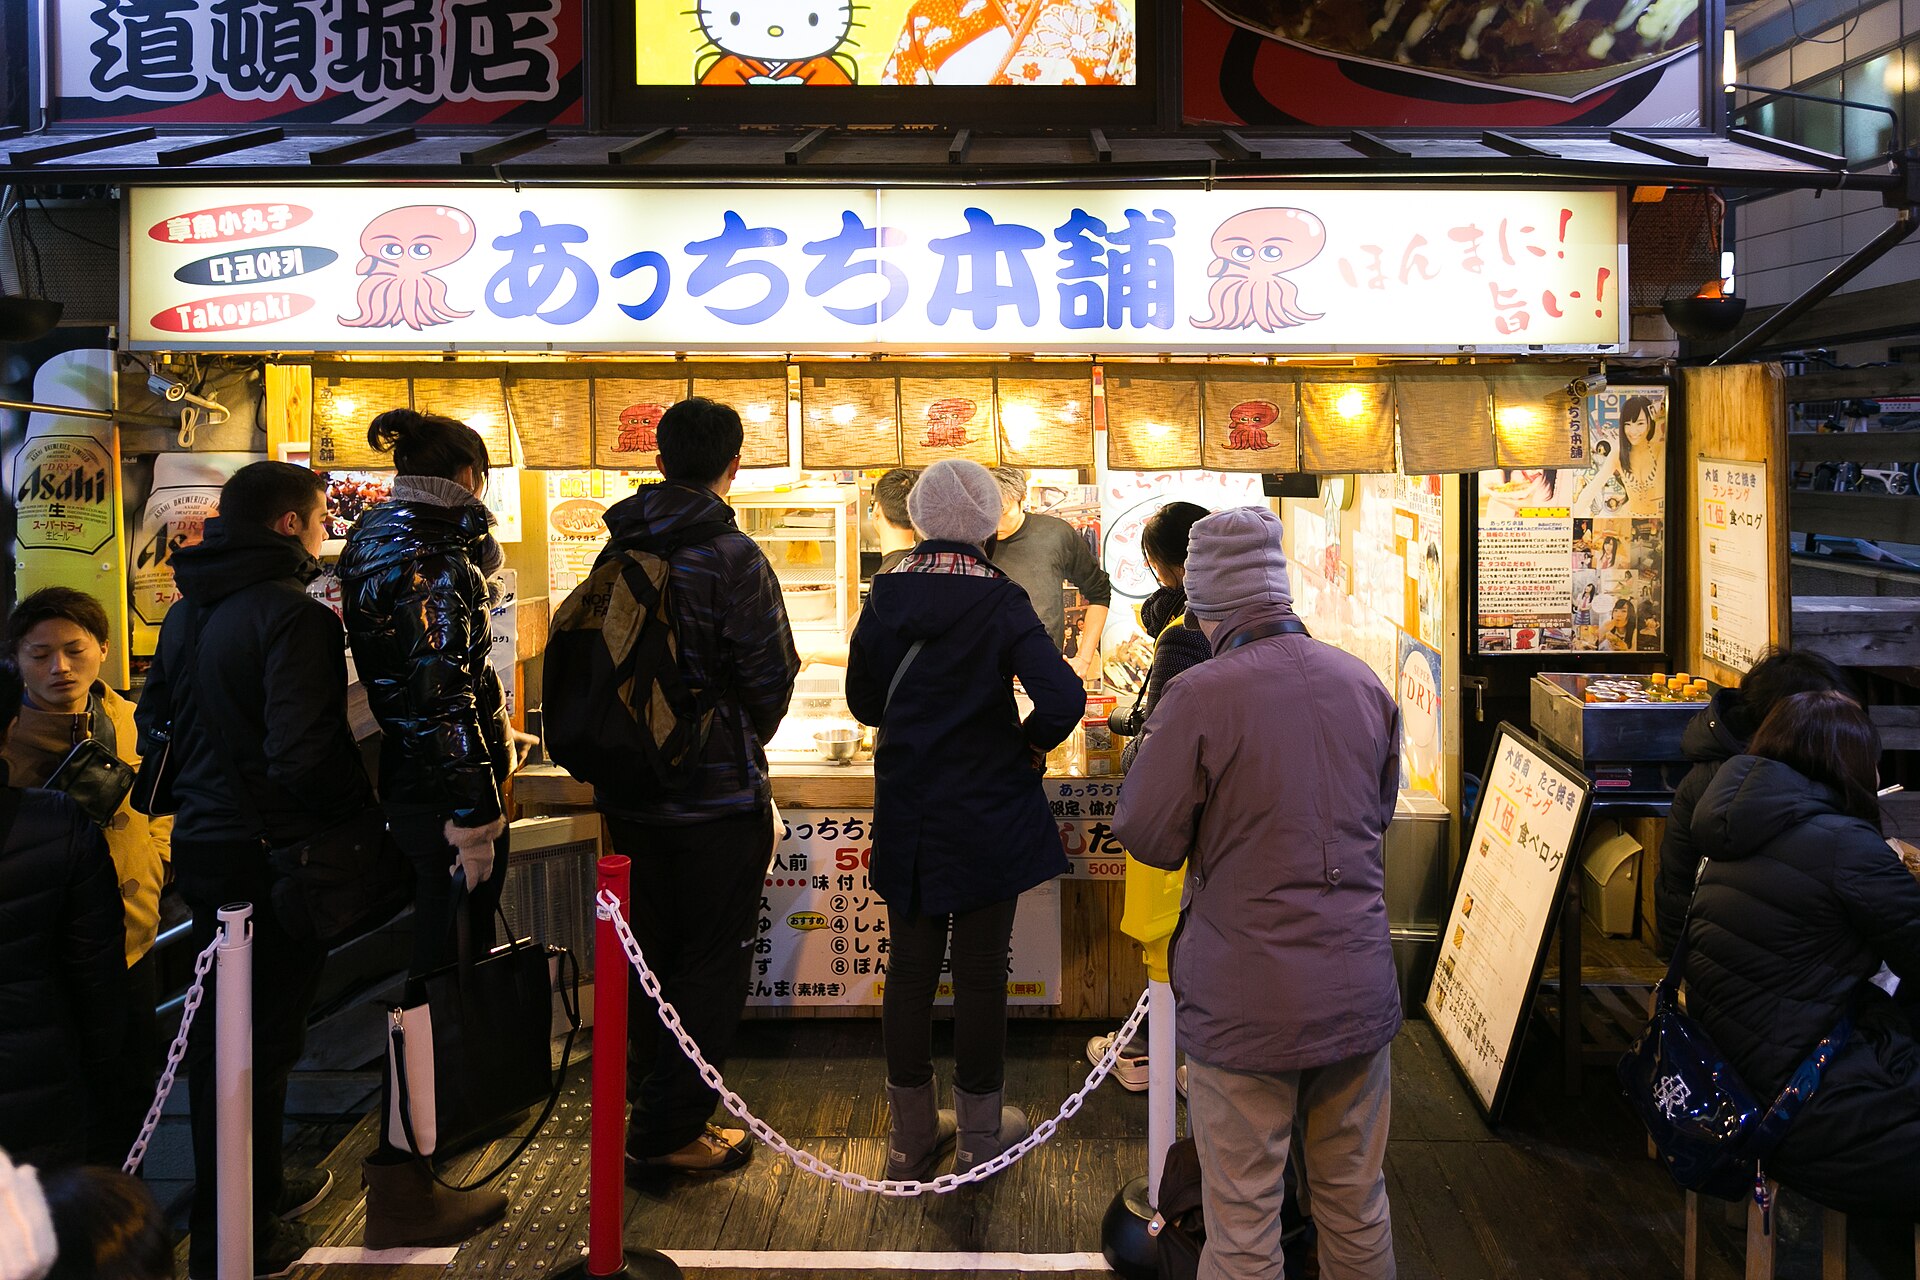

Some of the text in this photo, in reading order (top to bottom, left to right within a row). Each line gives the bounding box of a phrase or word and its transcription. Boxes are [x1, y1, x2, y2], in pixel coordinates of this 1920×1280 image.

[167, 205, 292, 242] 章魚小丸子
[210, 249, 304, 284] 다코야키
[485, 207, 1176, 330] あっちち本舗
[176, 293, 291, 331] Takoyaki
[18, 464, 104, 505] Asahi
[1727, 471, 1756, 488] たこ焼き
[1713, 485, 1750, 502] ランキング
[48, 502, 66, 518] 生
[154, 503, 170, 519] ASAHI
[173, 495, 208, 506] BREWERIES
[33, 521, 83, 532] スーパードライ
[1729, 509, 1763, 530] 食べログ
[45, 531, 70, 541] 生ビール
[1508, 771, 1553, 816] ランキング
[1537, 770, 1576, 812] たこ焼き
[781, 817, 873, 841] っちち
[1517, 821, 1564, 872] 食べログ
[790, 918, 825, 926] おすすめ
